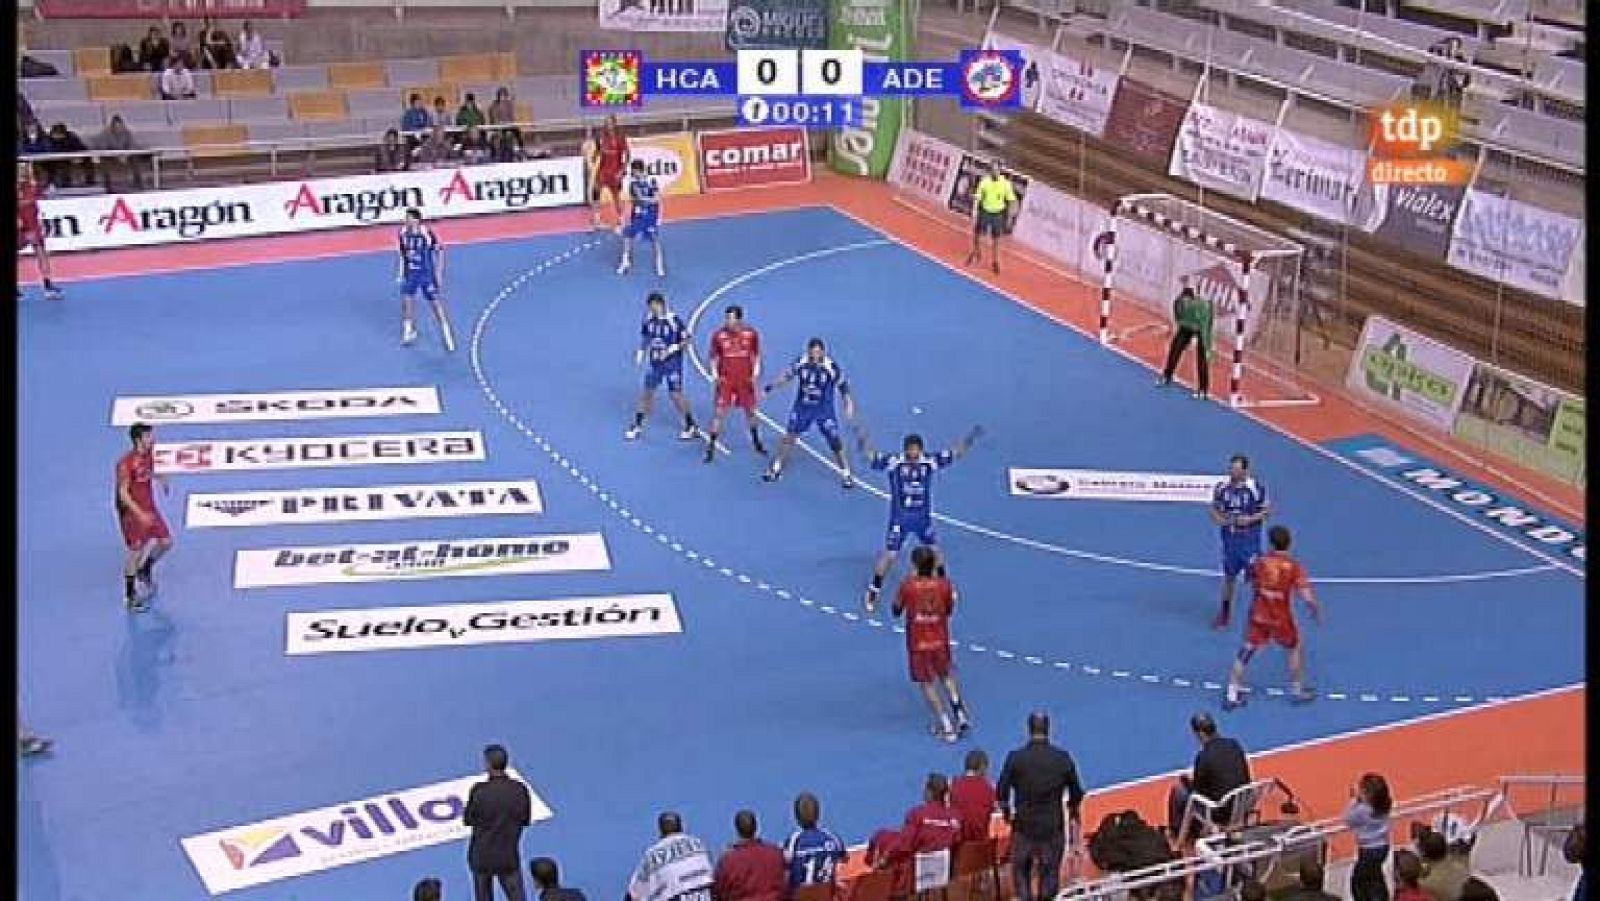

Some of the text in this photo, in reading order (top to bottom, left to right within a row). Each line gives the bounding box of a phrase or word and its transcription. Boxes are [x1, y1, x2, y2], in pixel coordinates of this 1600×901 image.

[705, 141, 802, 166] comar
[98, 196, 254, 238] Aragón
[284, 183, 425, 221] Aragón
[439, 169, 570, 207] Aragón
[225, 435, 476, 465] KYOCERA
[281, 487, 533, 514] PRIVATA
[274, 540, 571, 568] bet-at-home
[303, 615, 449, 640] Suelo
[471, 603, 664, 631] Gestión
